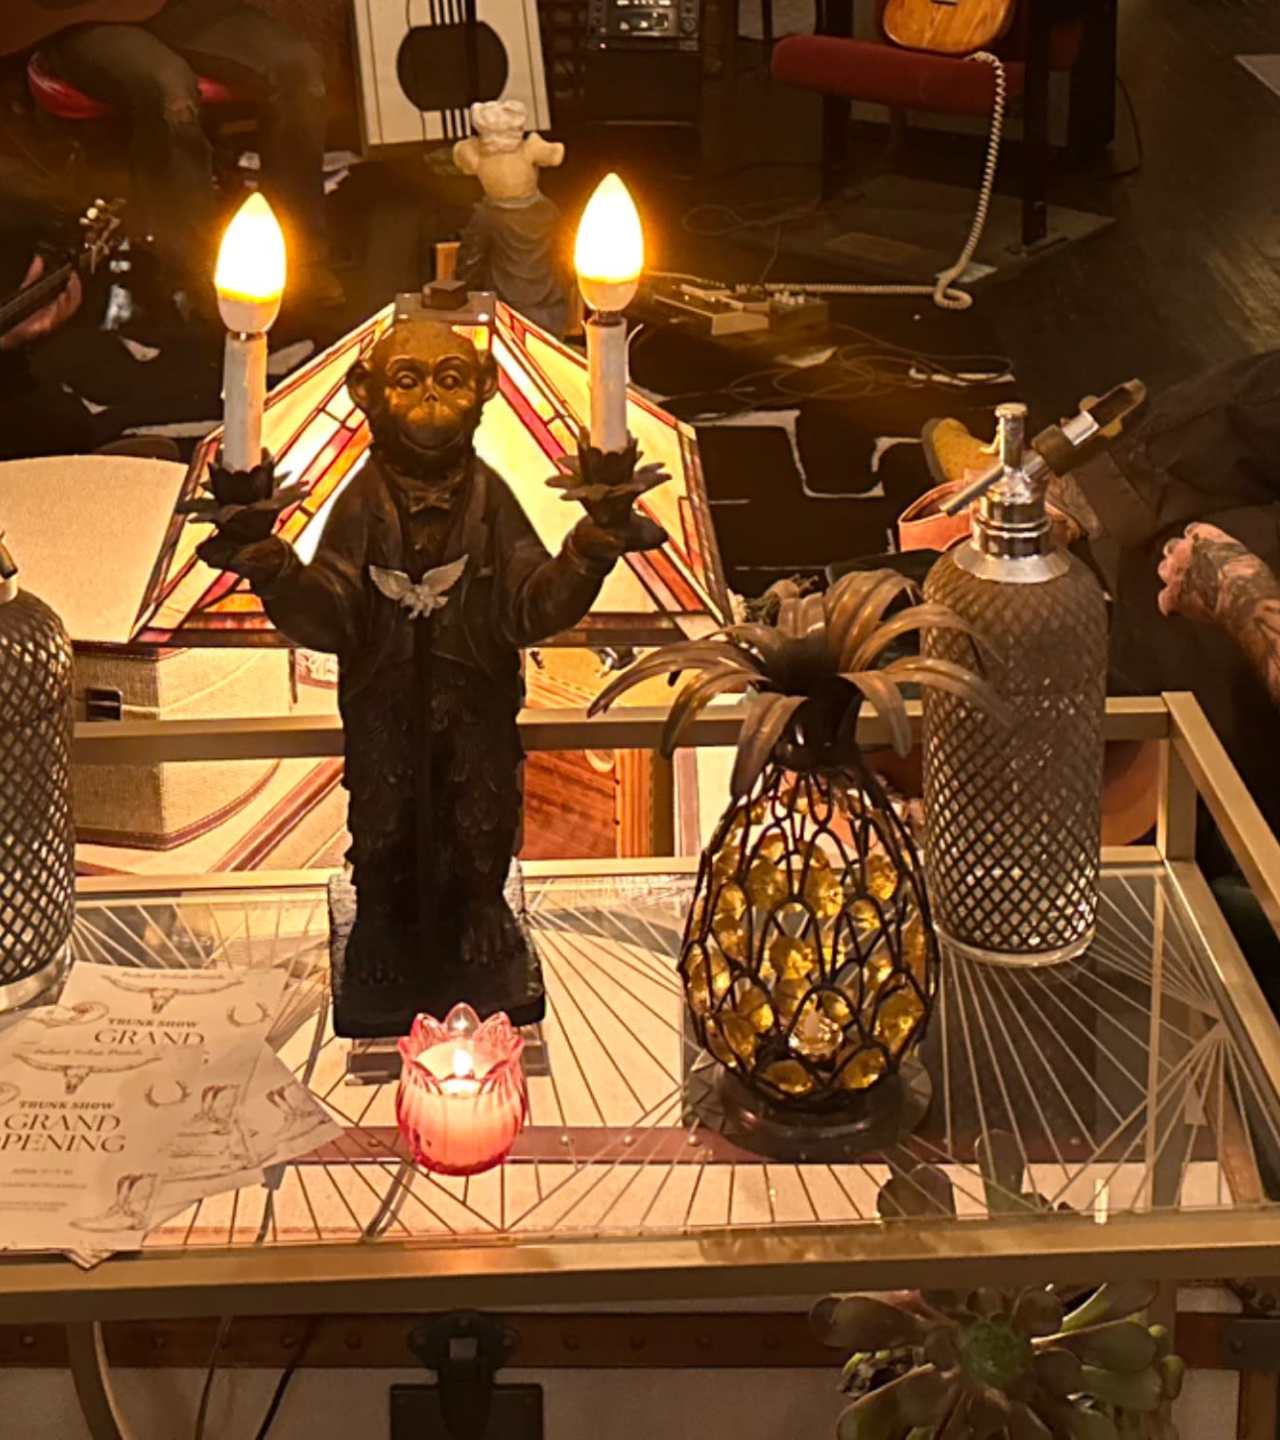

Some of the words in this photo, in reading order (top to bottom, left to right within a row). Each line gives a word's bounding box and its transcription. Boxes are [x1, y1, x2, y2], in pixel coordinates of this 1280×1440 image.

[109, 1018, 154, 1027] TRUNK
[157, 1019, 198, 1028] SHOW
[94, 1028, 205, 1045] GRAND
[19, 1101, 67, 1110] TRUNK
[70, 1101, 114, 1110] SHOW
[4, 1113, 121, 1132] GRAND
